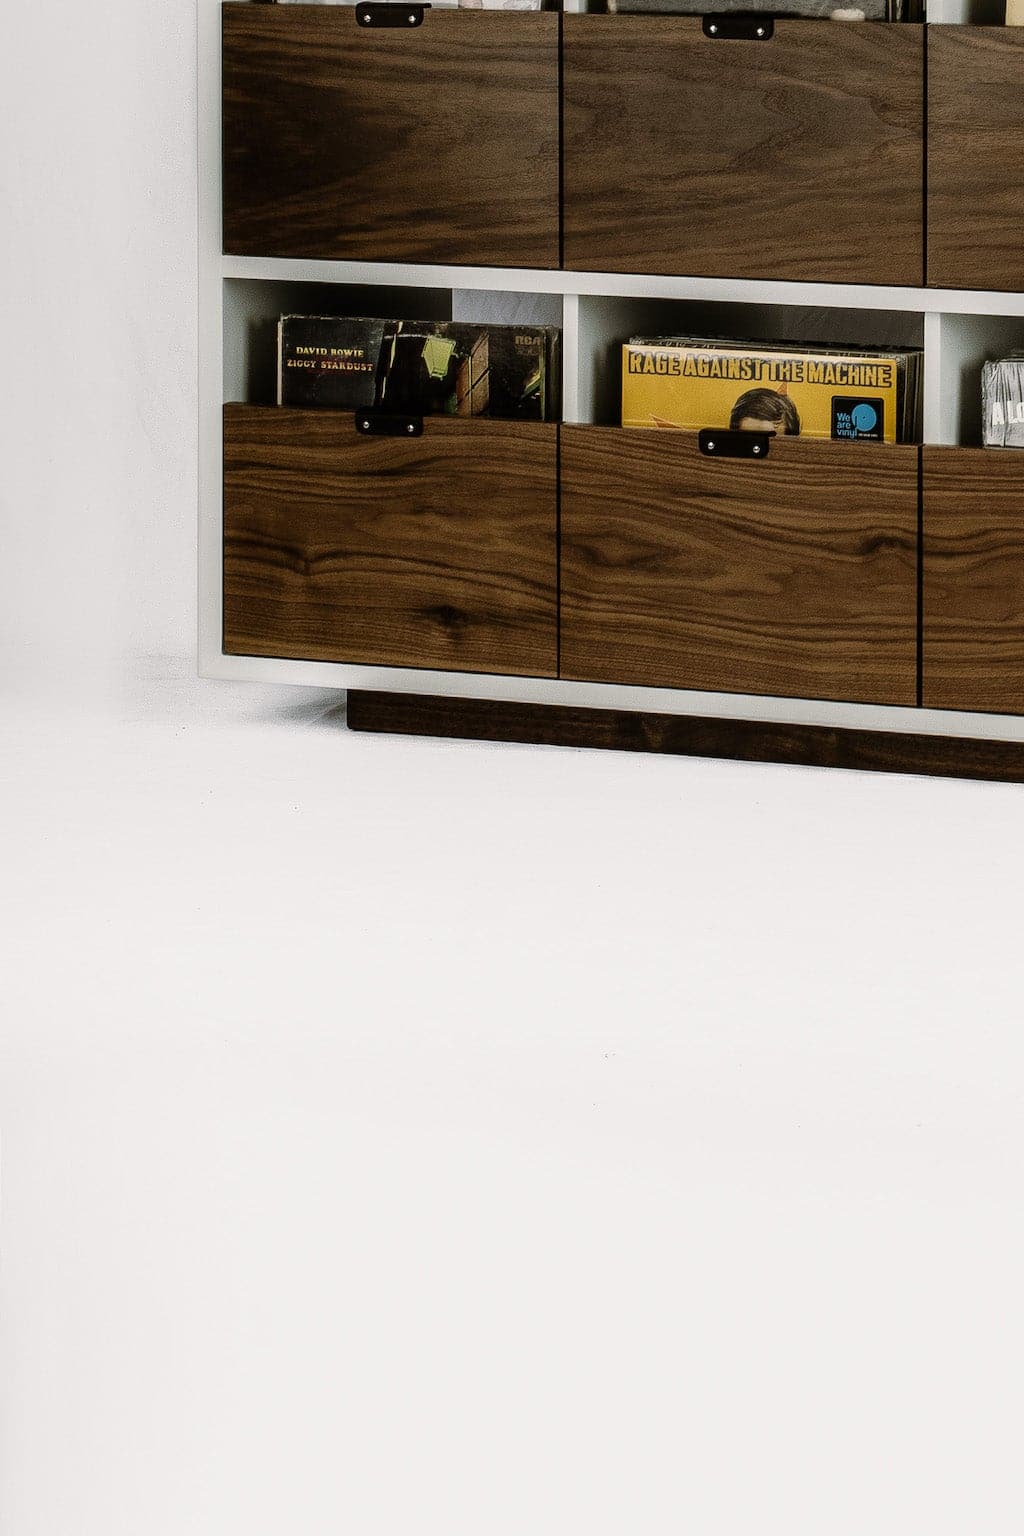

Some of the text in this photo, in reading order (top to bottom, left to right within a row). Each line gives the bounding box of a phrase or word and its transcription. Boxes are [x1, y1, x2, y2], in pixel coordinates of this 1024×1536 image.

[296, 346, 364, 358] DAVID BOWIE
[287, 360, 373, 372] ZIGGY STARDUST
[628, 351, 893, 388] RAGE AGAINST THE MACHINE
[836, 413, 851, 421] We
[992, 402, 1004, 425] A
[836, 421, 851, 429] are
[836, 428, 858, 439] vinyl
